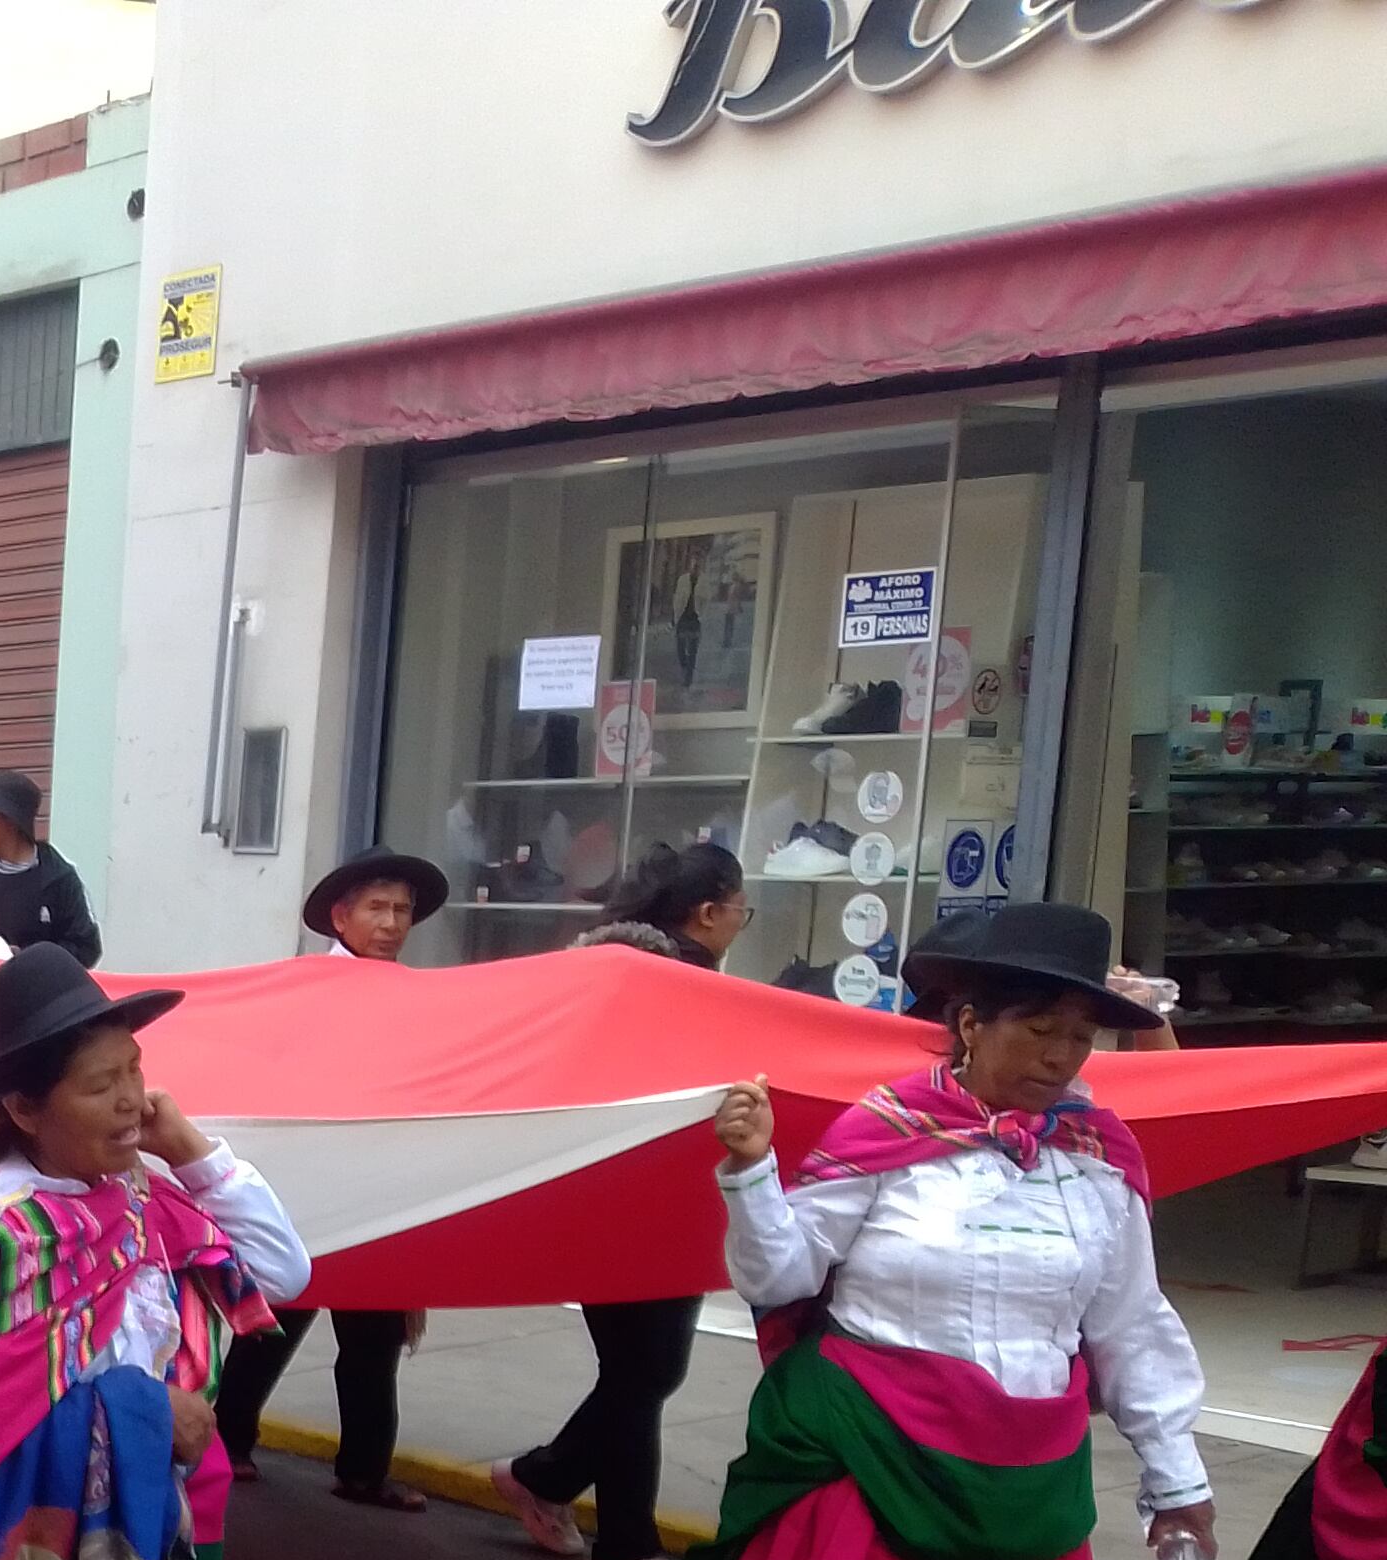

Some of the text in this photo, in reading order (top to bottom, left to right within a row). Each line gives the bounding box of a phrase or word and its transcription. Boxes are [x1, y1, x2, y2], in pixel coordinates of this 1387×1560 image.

[626, 0, 1261, 148] Ba
[159, 336, 212, 356] PROSEGUR
[878, 574, 922, 588] AFORO
[850, 614, 929, 637] 19 PERSONAS
